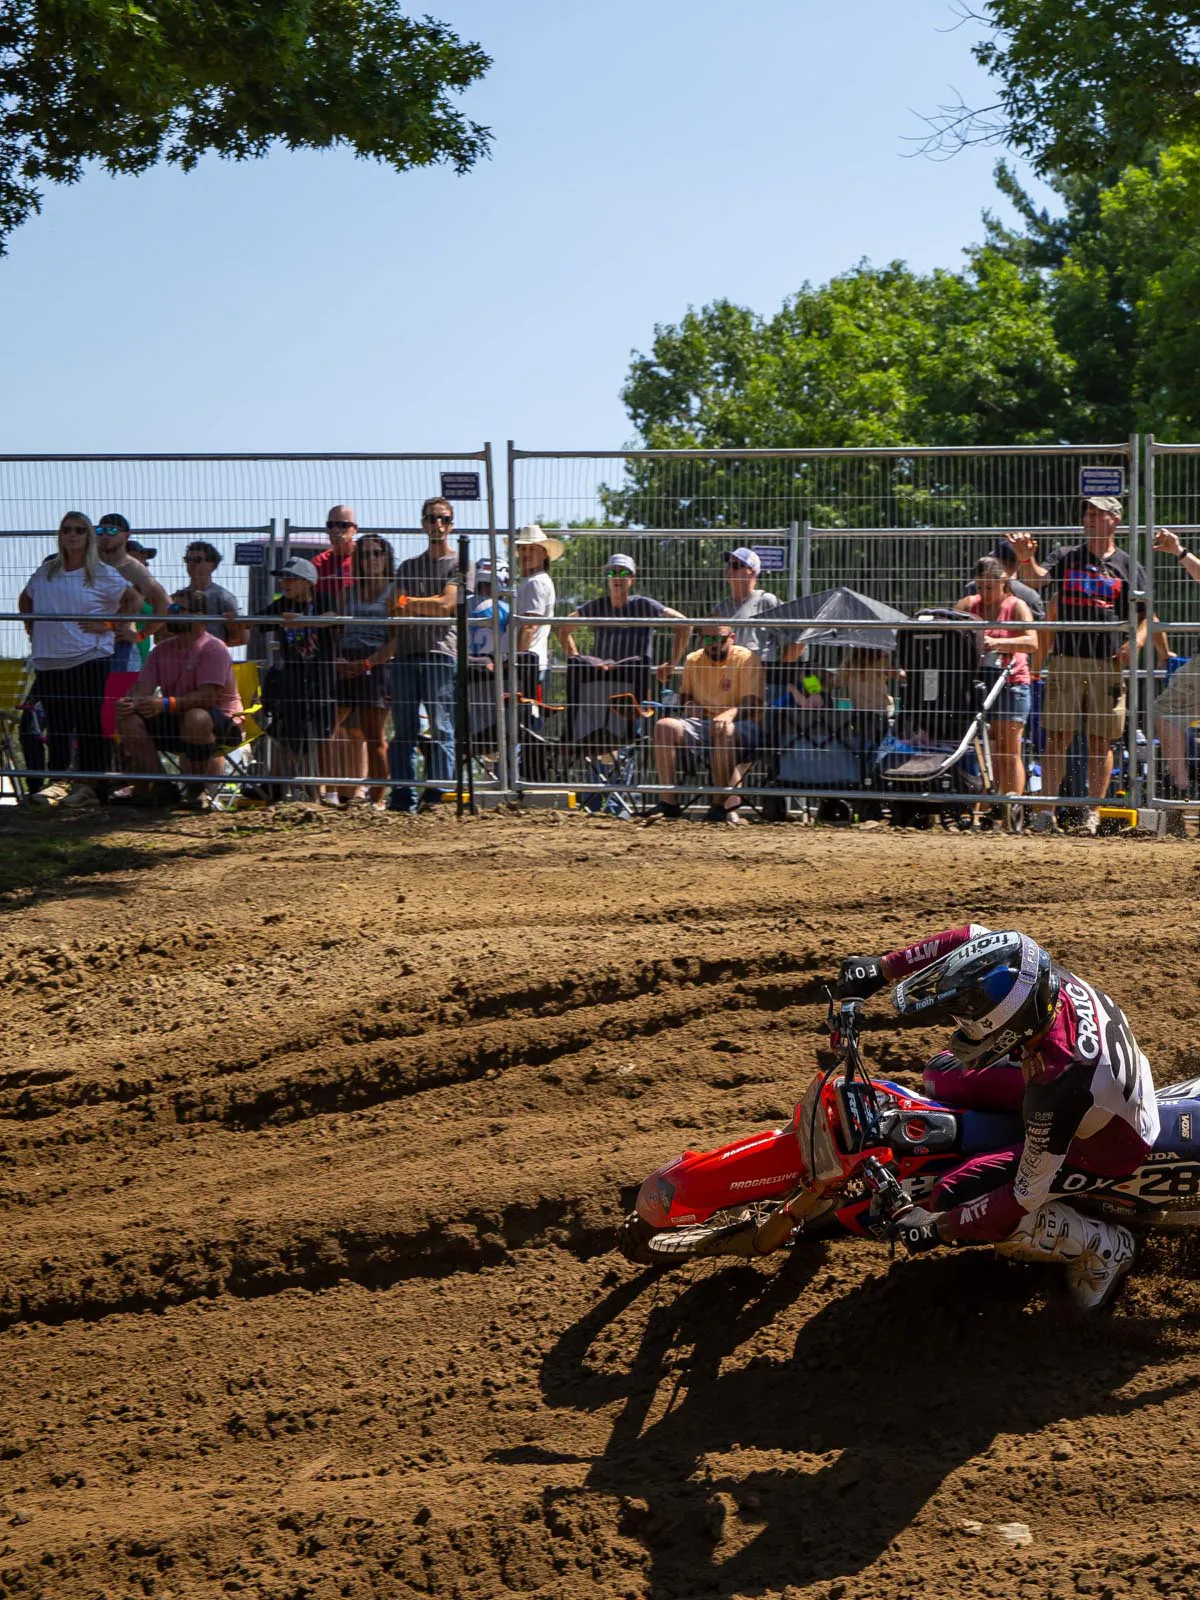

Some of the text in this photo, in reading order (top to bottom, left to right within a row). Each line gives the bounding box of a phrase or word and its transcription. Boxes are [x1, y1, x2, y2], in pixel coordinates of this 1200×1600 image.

[958, 934, 1011, 961] froth
[844, 963, 877, 983] FOX
[915, 997, 934, 1012] froth
[1065, 982, 1100, 1060] CRAIG
[729, 1171, 799, 1190] PROGRESSIVE
[959, 1198, 989, 1225] MTF
[1047, 1207, 1056, 1238] FOX
[901, 1226, 932, 1242] FOX
